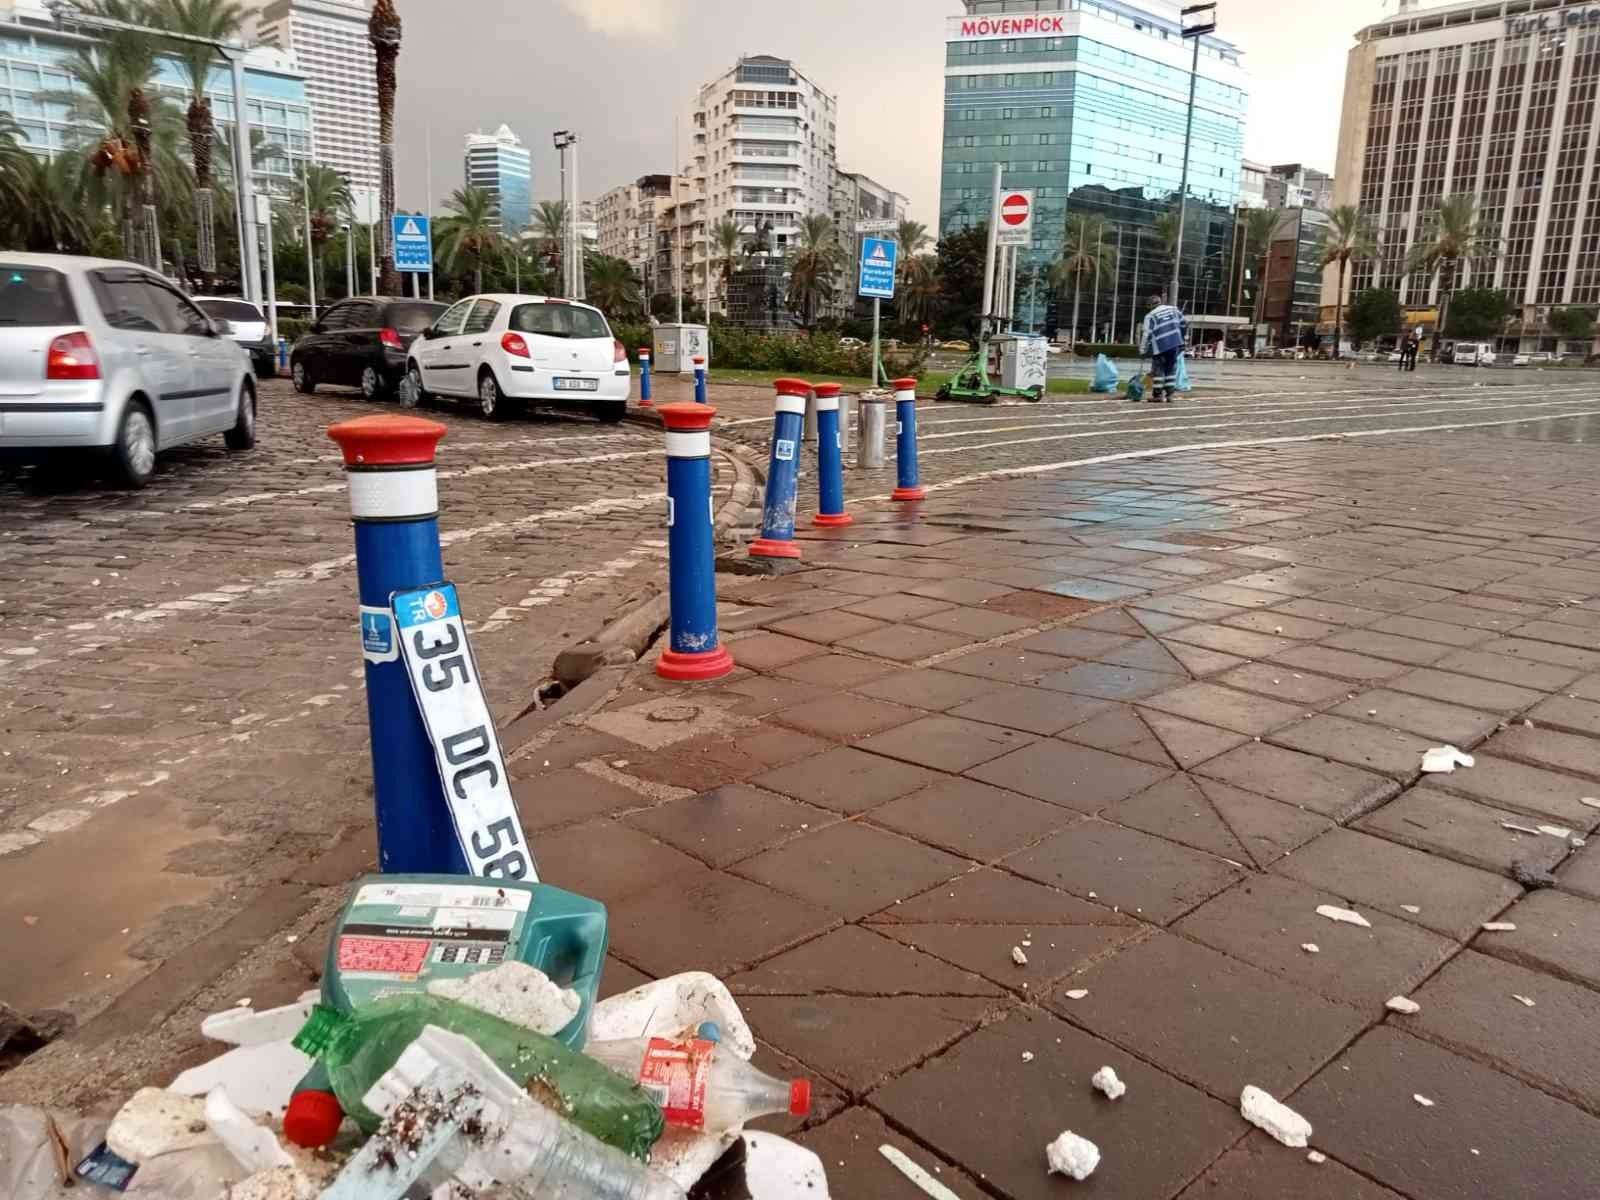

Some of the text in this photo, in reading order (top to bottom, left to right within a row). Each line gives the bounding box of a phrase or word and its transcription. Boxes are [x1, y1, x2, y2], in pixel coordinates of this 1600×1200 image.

[409, 597, 427, 623] TR
[412, 623, 470, 693] 35
[441, 724, 499, 800] DC
